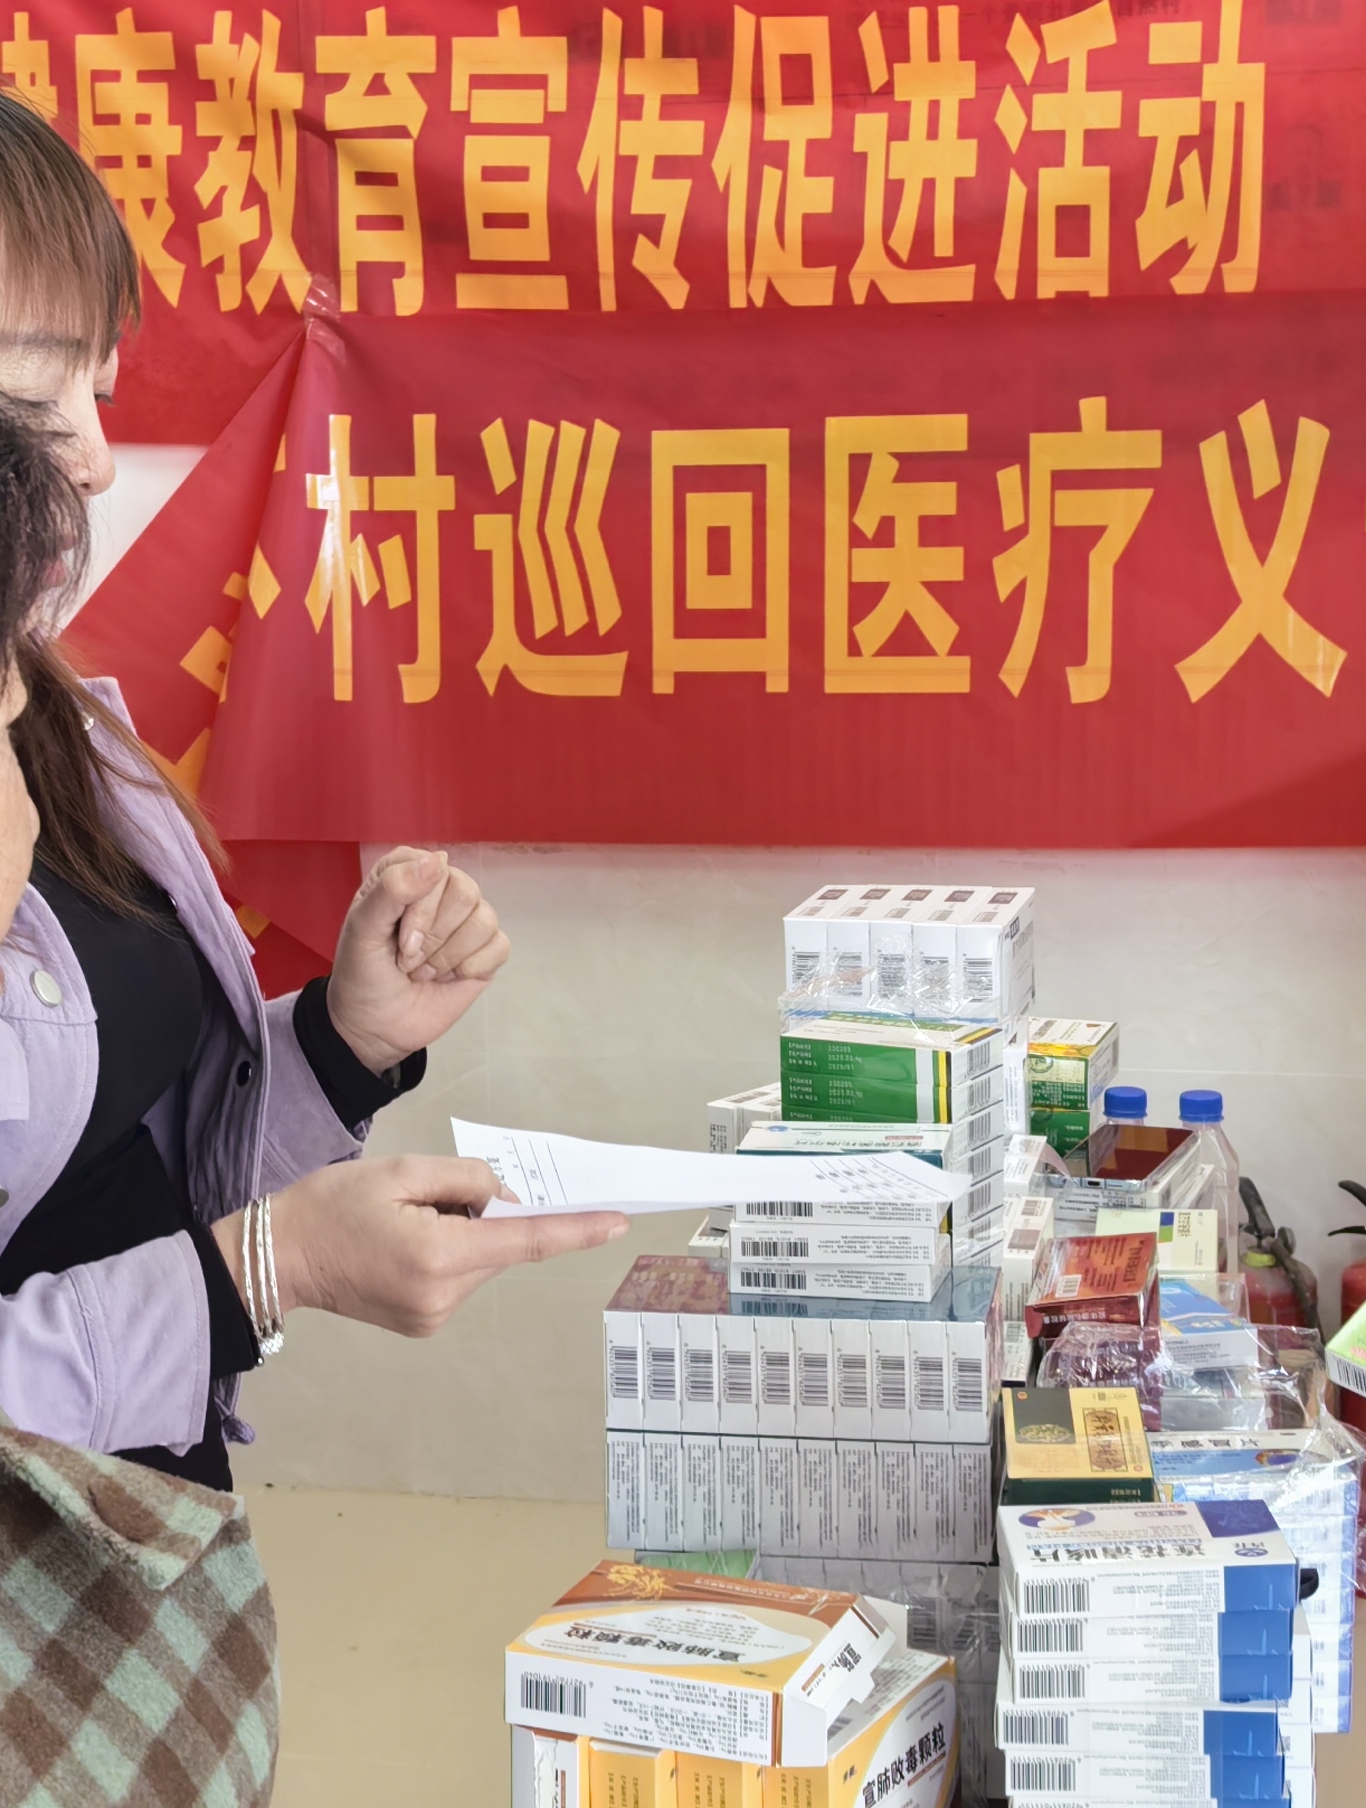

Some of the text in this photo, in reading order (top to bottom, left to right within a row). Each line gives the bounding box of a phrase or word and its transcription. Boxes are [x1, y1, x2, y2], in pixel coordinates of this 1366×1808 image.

[563, 1625, 746, 1663] 宣肺败毒颗粒
[862, 1721, 947, 1808] 宣肺败毒颗粒
